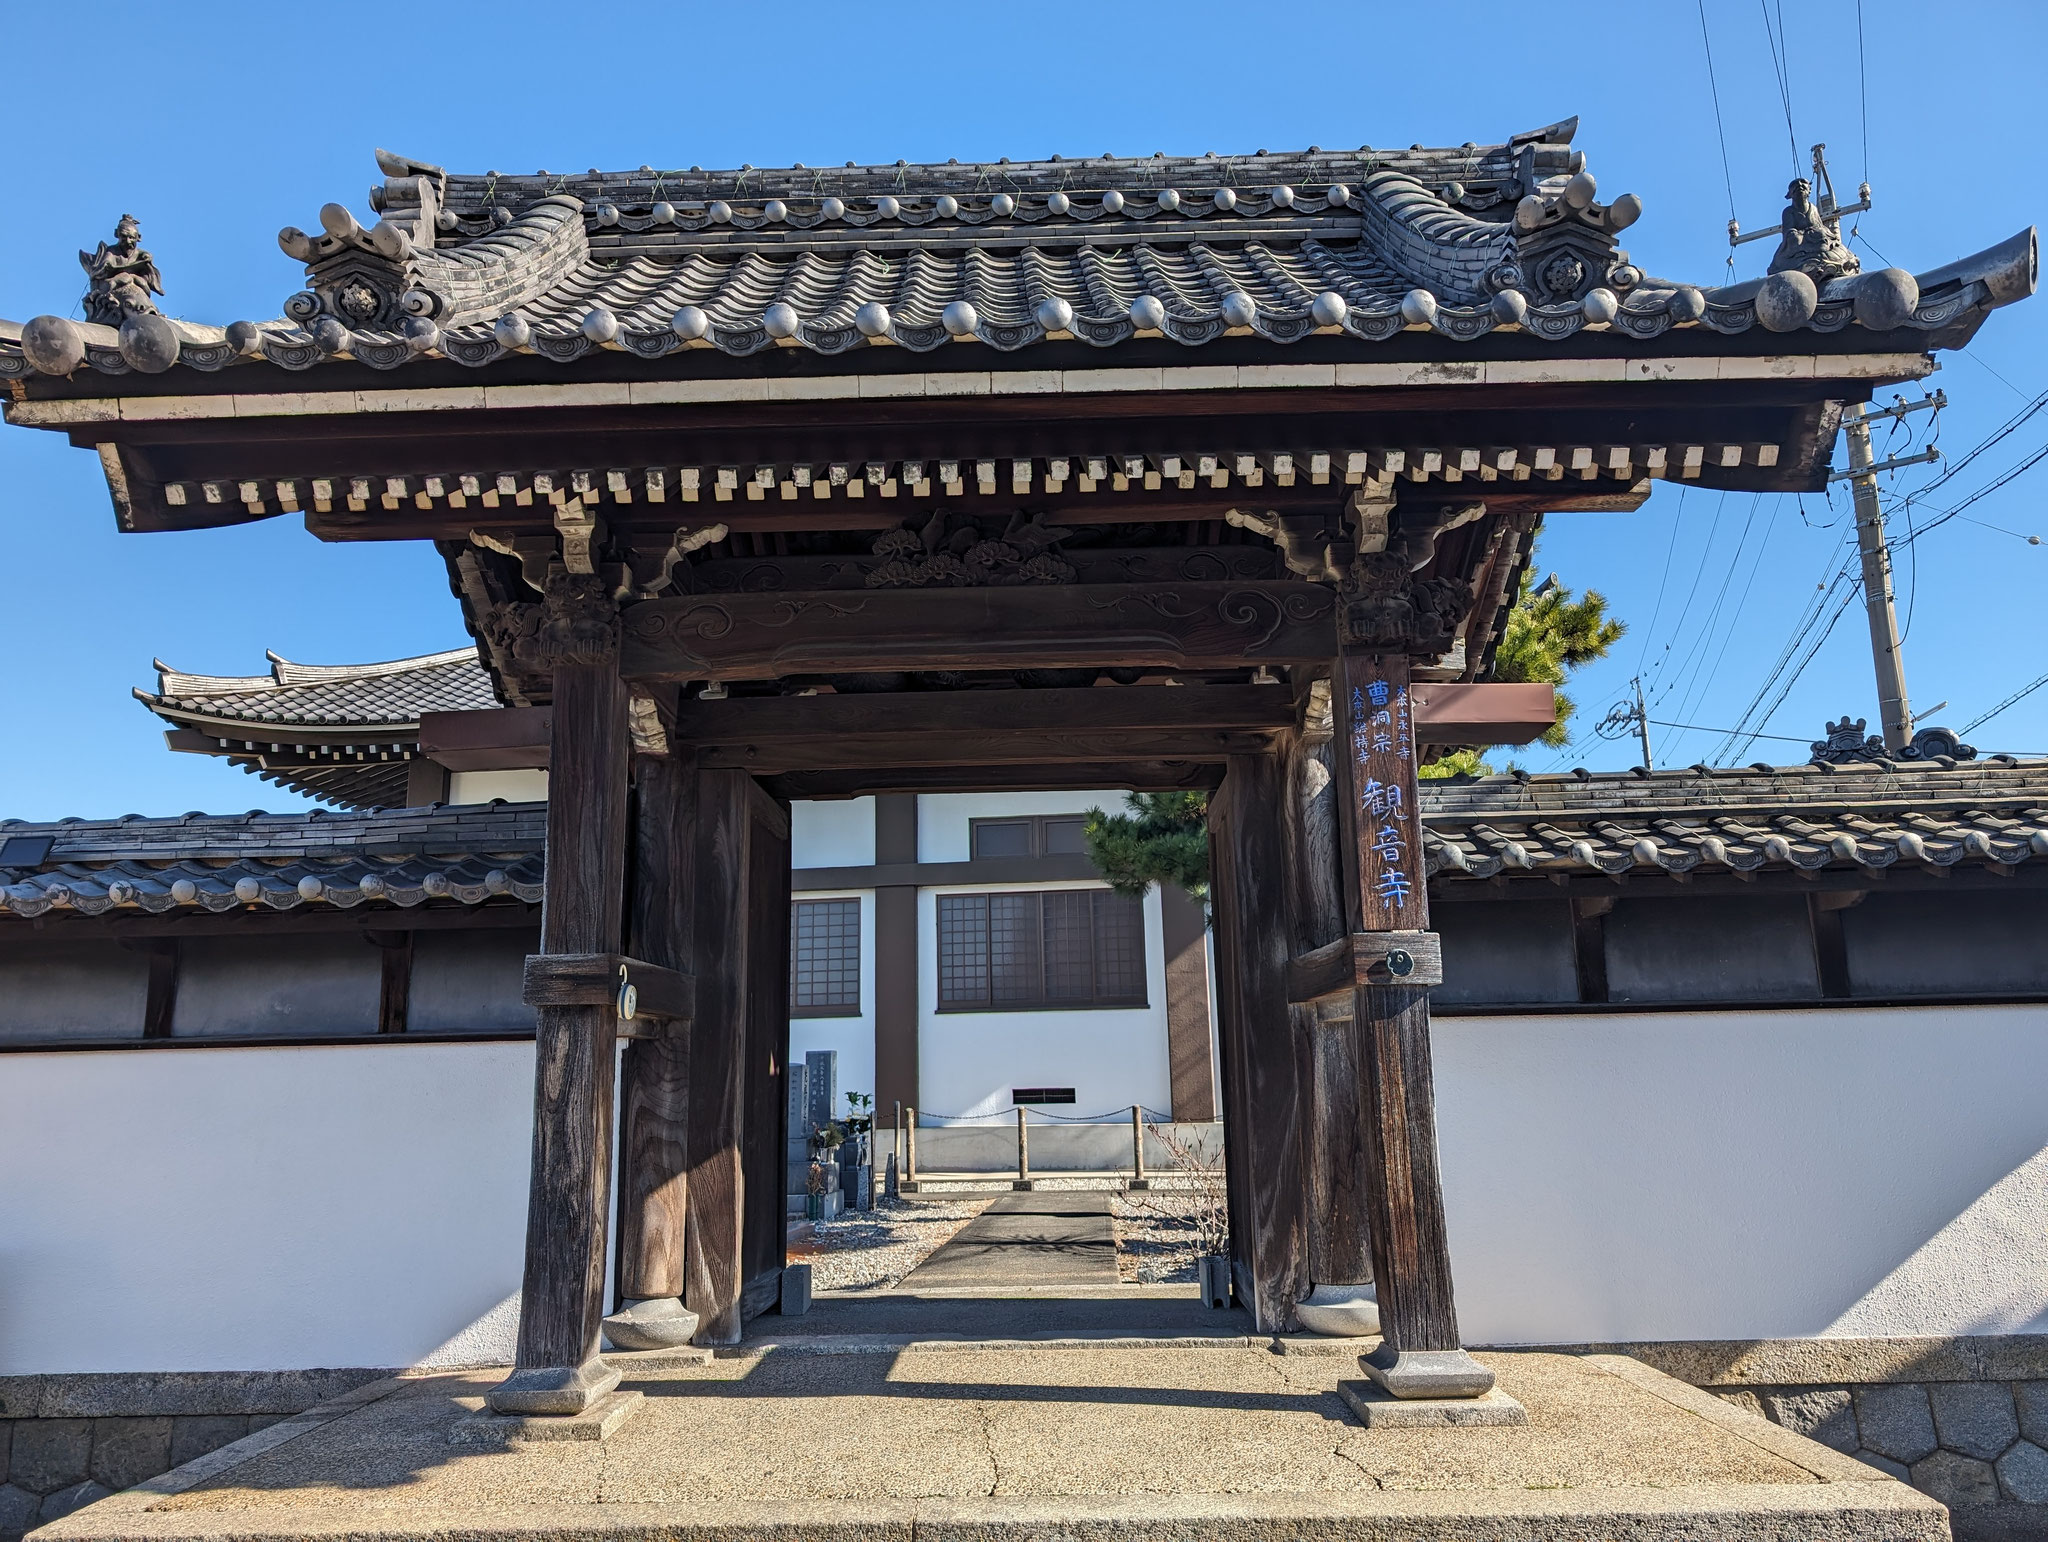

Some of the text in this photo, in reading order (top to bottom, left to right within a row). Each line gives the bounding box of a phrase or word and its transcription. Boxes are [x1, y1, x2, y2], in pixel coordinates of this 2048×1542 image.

[1360, 679, 1411, 910] 曹洞宗 観音寺
